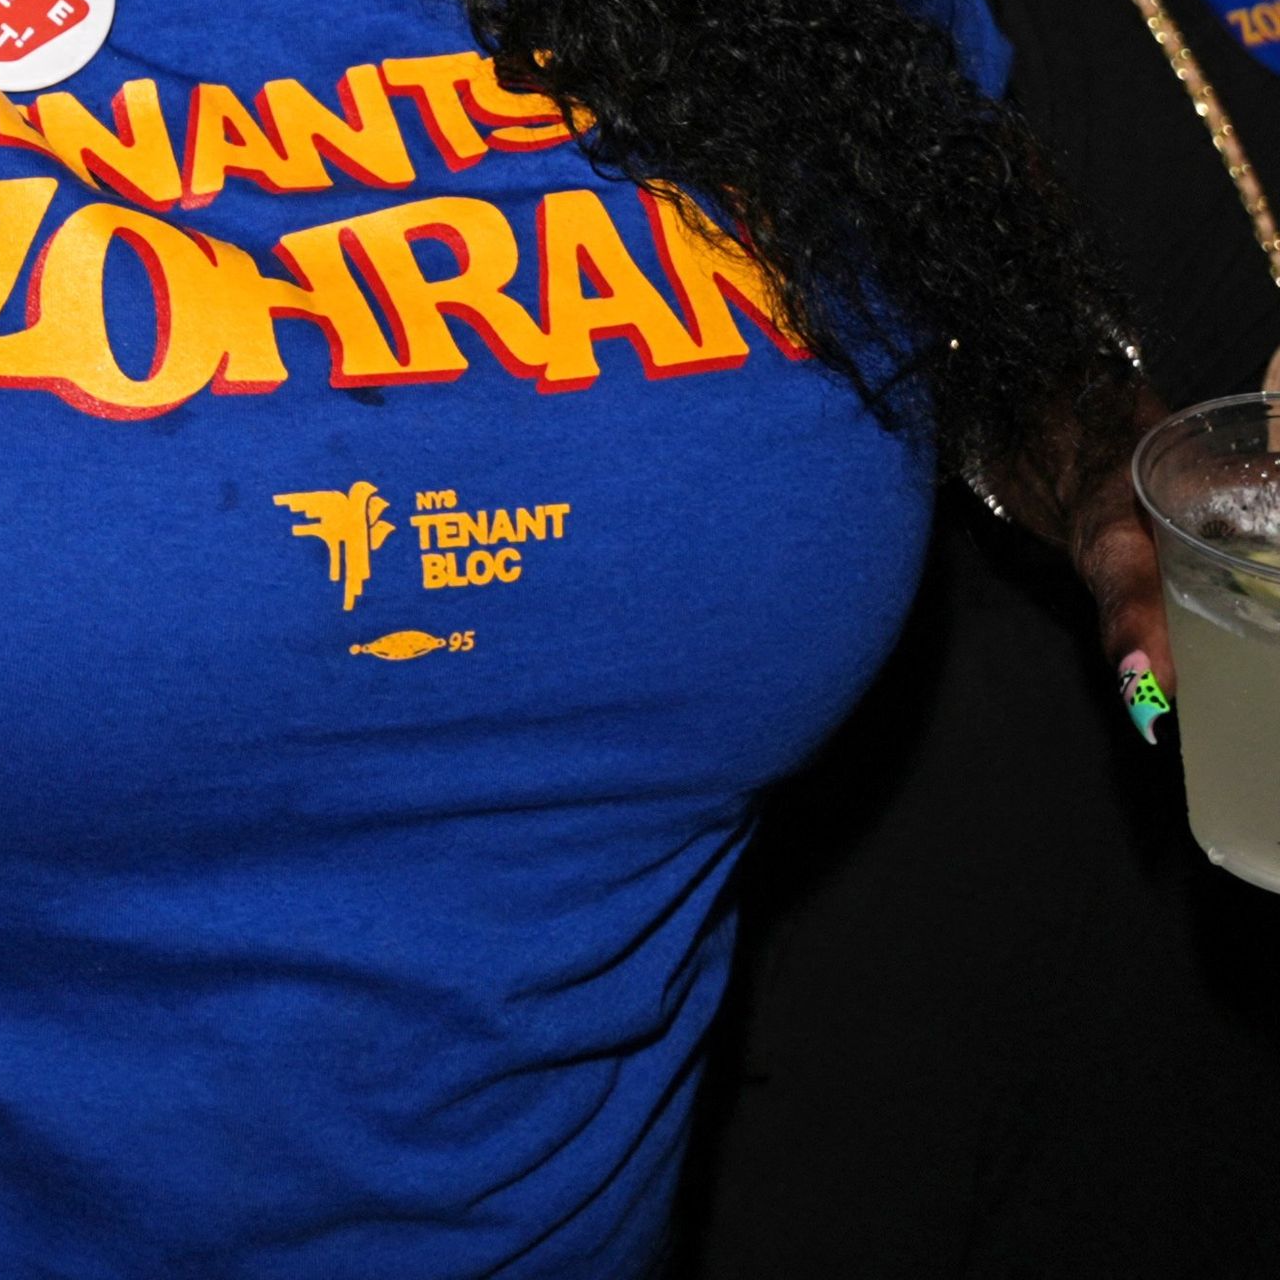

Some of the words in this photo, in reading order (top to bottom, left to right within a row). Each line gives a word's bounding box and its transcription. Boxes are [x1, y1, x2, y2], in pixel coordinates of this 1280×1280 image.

[415, 489, 458, 512] NYS
[409, 502, 571, 550] TENANT
[420, 546, 523, 589] BLOC
[448, 630, 476, 652] 95
